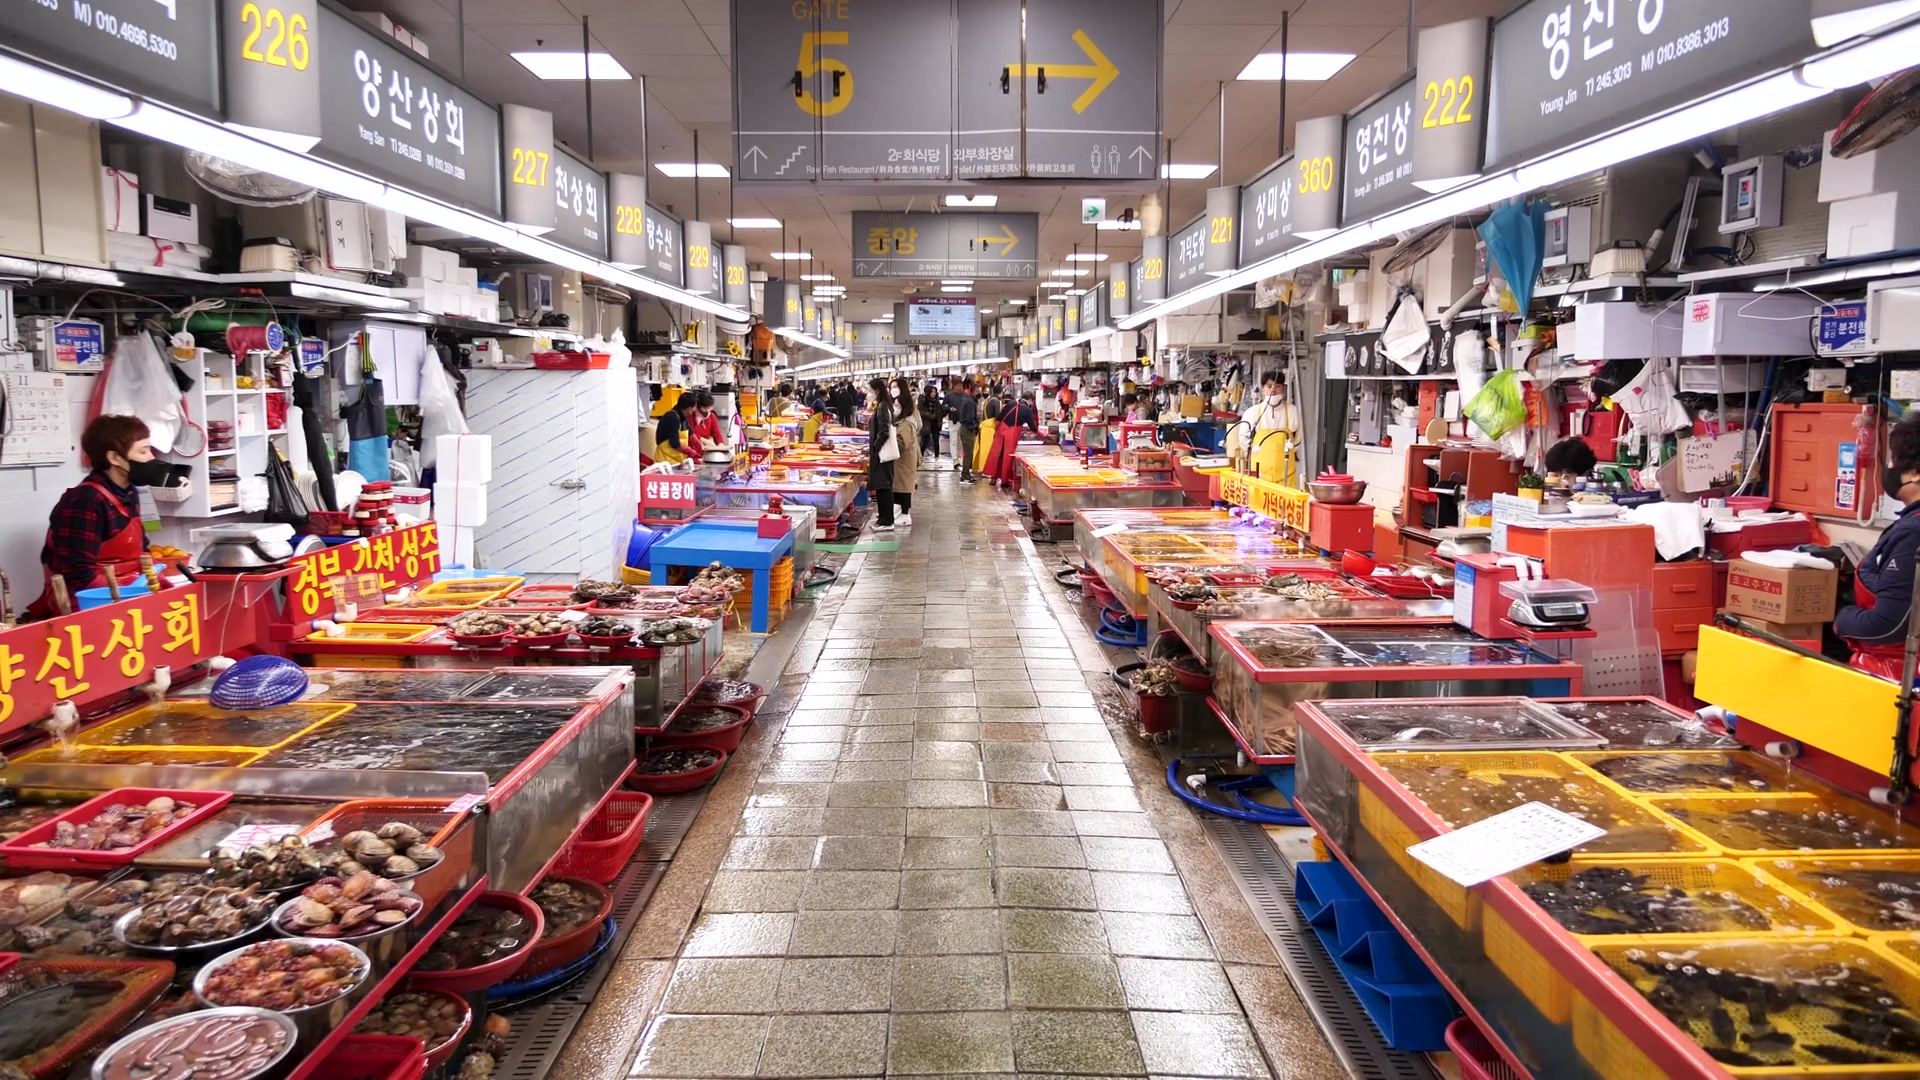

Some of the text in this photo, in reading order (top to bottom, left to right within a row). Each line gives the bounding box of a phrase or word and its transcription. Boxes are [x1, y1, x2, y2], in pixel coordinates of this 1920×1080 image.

[792, 0, 849, 19] GATE
[74, 1, 92, 26] M)
[95, 10, 177, 60] 010.4696.5300
[241, 3, 310, 71] 226
[793, 32, 854, 117] 5
[1540, 96, 1564, 116] Young
[1565, 89, 1577, 105] Jin
[1596, 62, 1632, 92] 245.3013
[1656, 17, 1730, 65] 010.8386.3013
[354, 49, 465, 156] 양산상회
[1422, 75, 1473, 129] 222
[1355, 101, 1411, 175] 영진상
[512, 147, 549, 187] 227
[953, 146, 1014, 162] 외부화장실
[823, 165, 837, 174] Fish
[1298, 156, 1333, 194] 360
[616, 205, 643, 235] 228
[1210, 217, 1233, 244] 221
[867, 227, 919, 255] 중앙
[689, 245, 709, 268] 229
[1144, 258, 1163, 280] 220
[727, 266, 744, 285] 230
[1112, 281, 1126, 299] 219
[73, 340, 98, 353] 분전함
[646, 481, 694, 500] 산꼼장어
